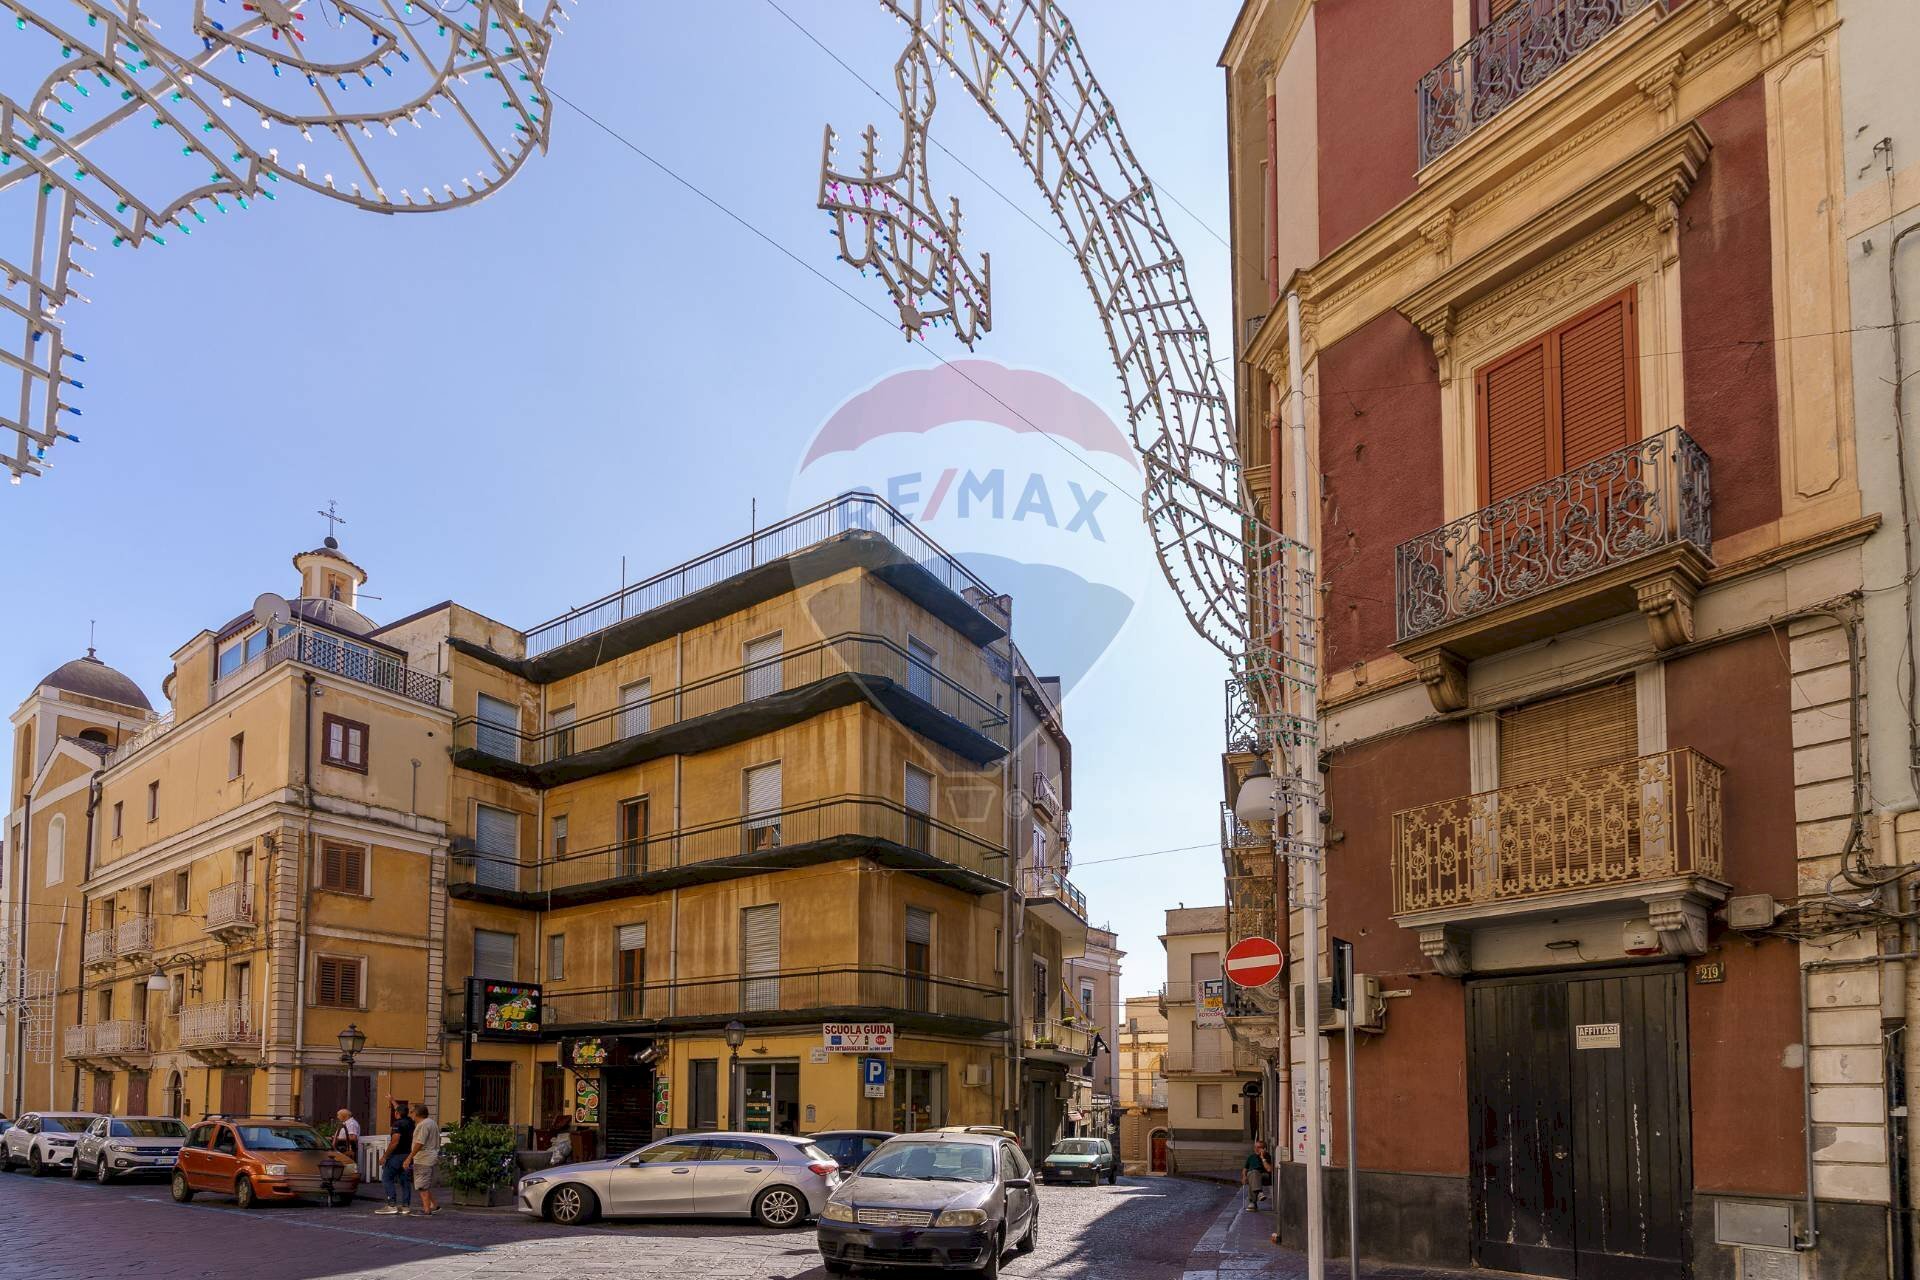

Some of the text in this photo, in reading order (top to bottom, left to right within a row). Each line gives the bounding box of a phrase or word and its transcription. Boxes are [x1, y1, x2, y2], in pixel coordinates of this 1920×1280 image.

[1701, 966, 1718, 979] 219
[825, 1025, 892, 1034] SCUOLA GUIDA
[1579, 1026, 1617, 1036] AFFITTASI
[870, 1062, 882, 1082] P
